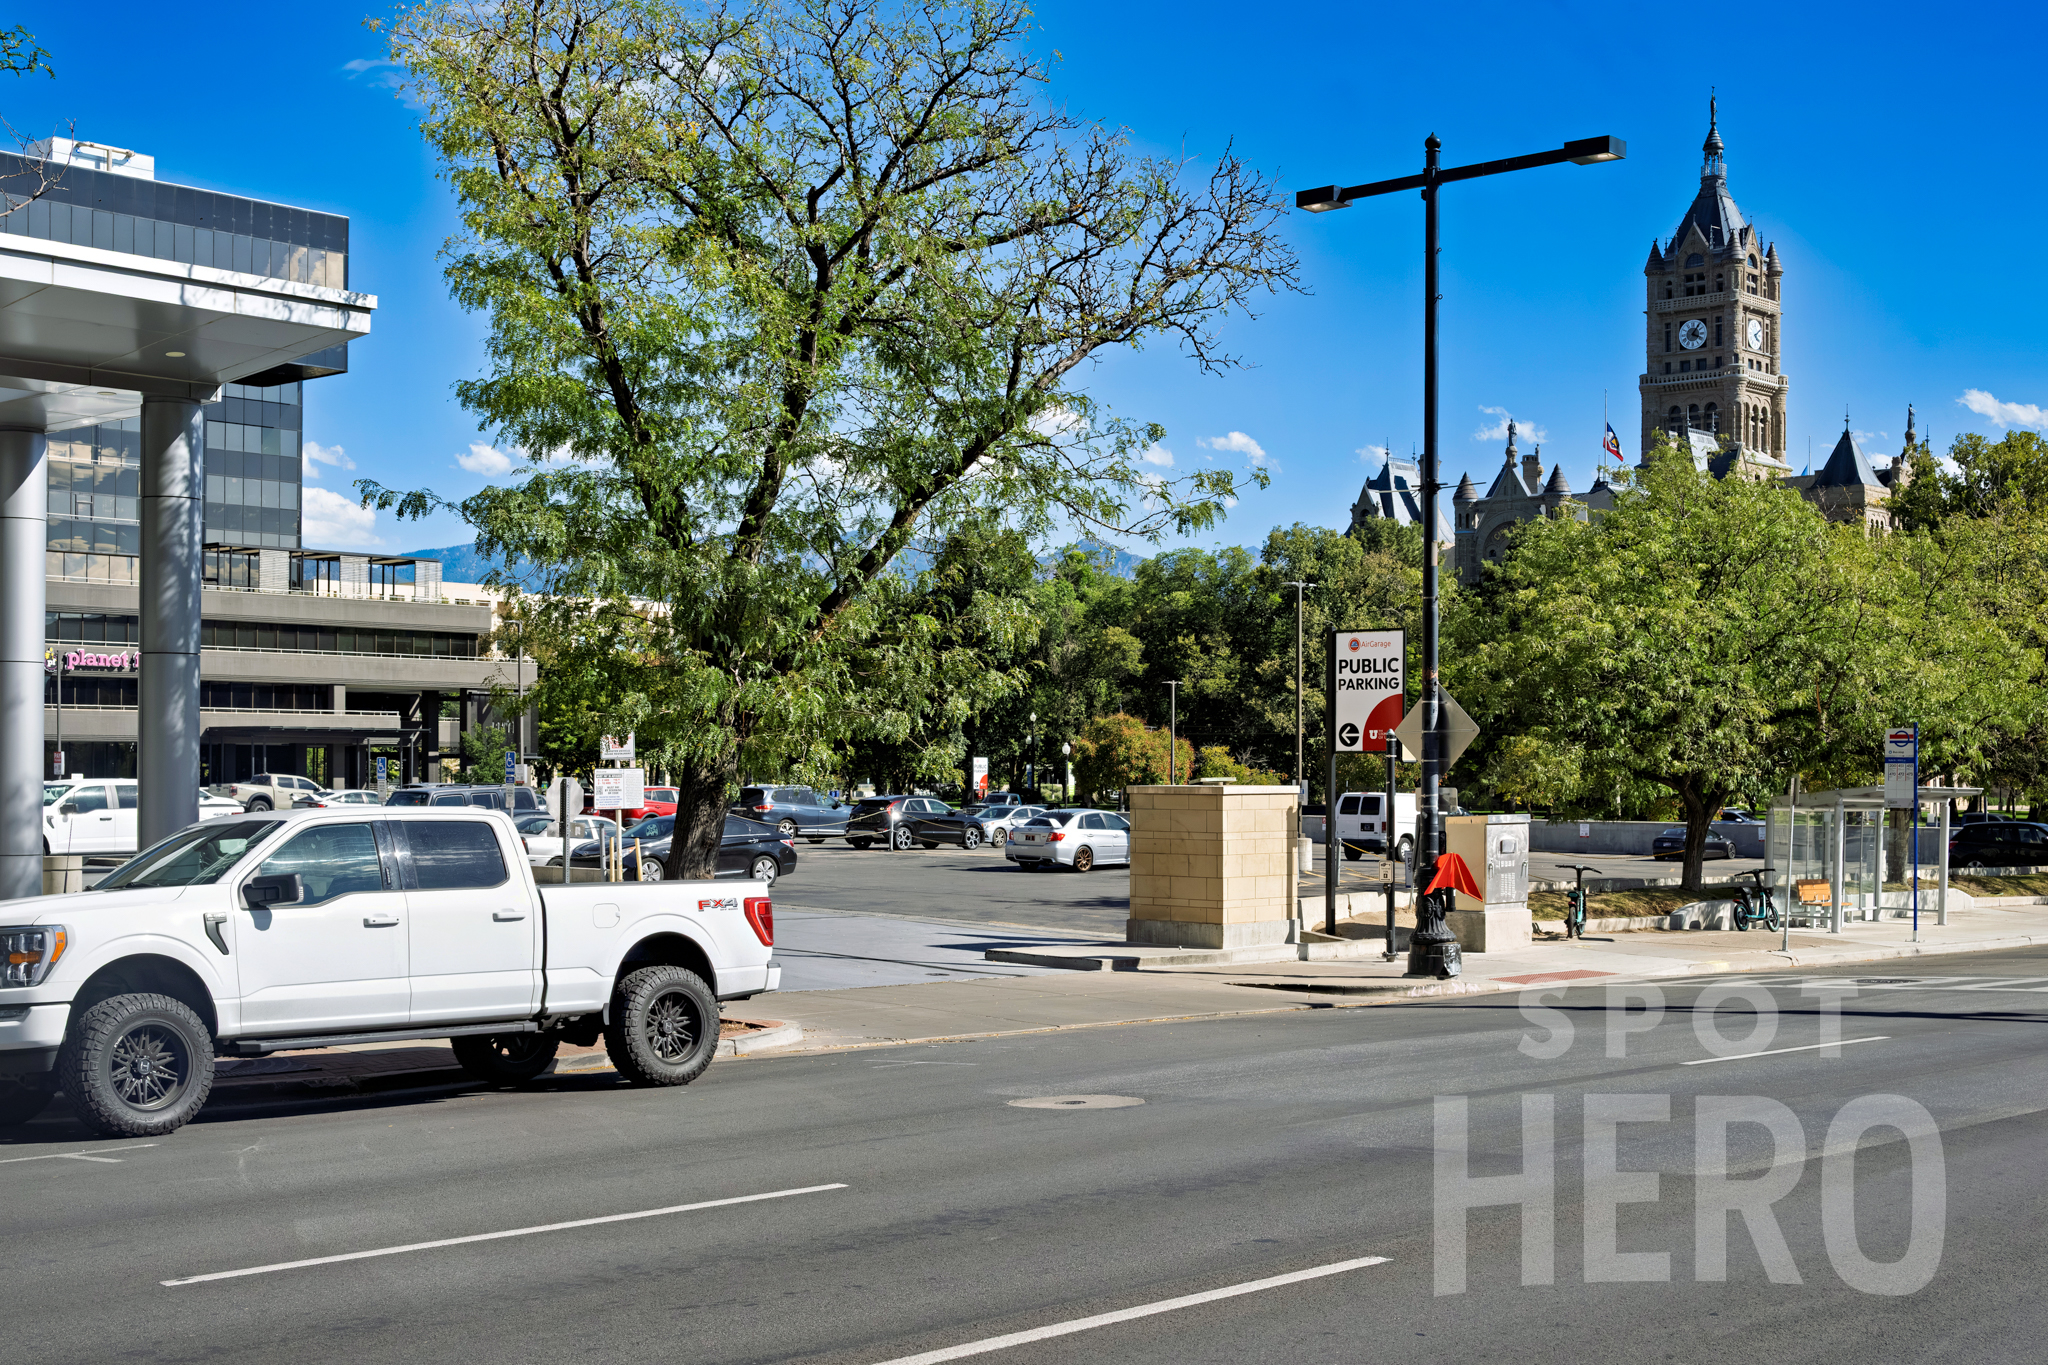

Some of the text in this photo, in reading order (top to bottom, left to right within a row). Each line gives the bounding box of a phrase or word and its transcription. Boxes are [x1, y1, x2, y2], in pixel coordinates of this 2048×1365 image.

[1361, 640, 1391, 648] AirGarage
[66, 649, 129, 670] planet
[1338, 657, 1399, 674] PUBLIC
[1338, 677, 1399, 691] PARKING
[697, 898, 738, 912] FX4
